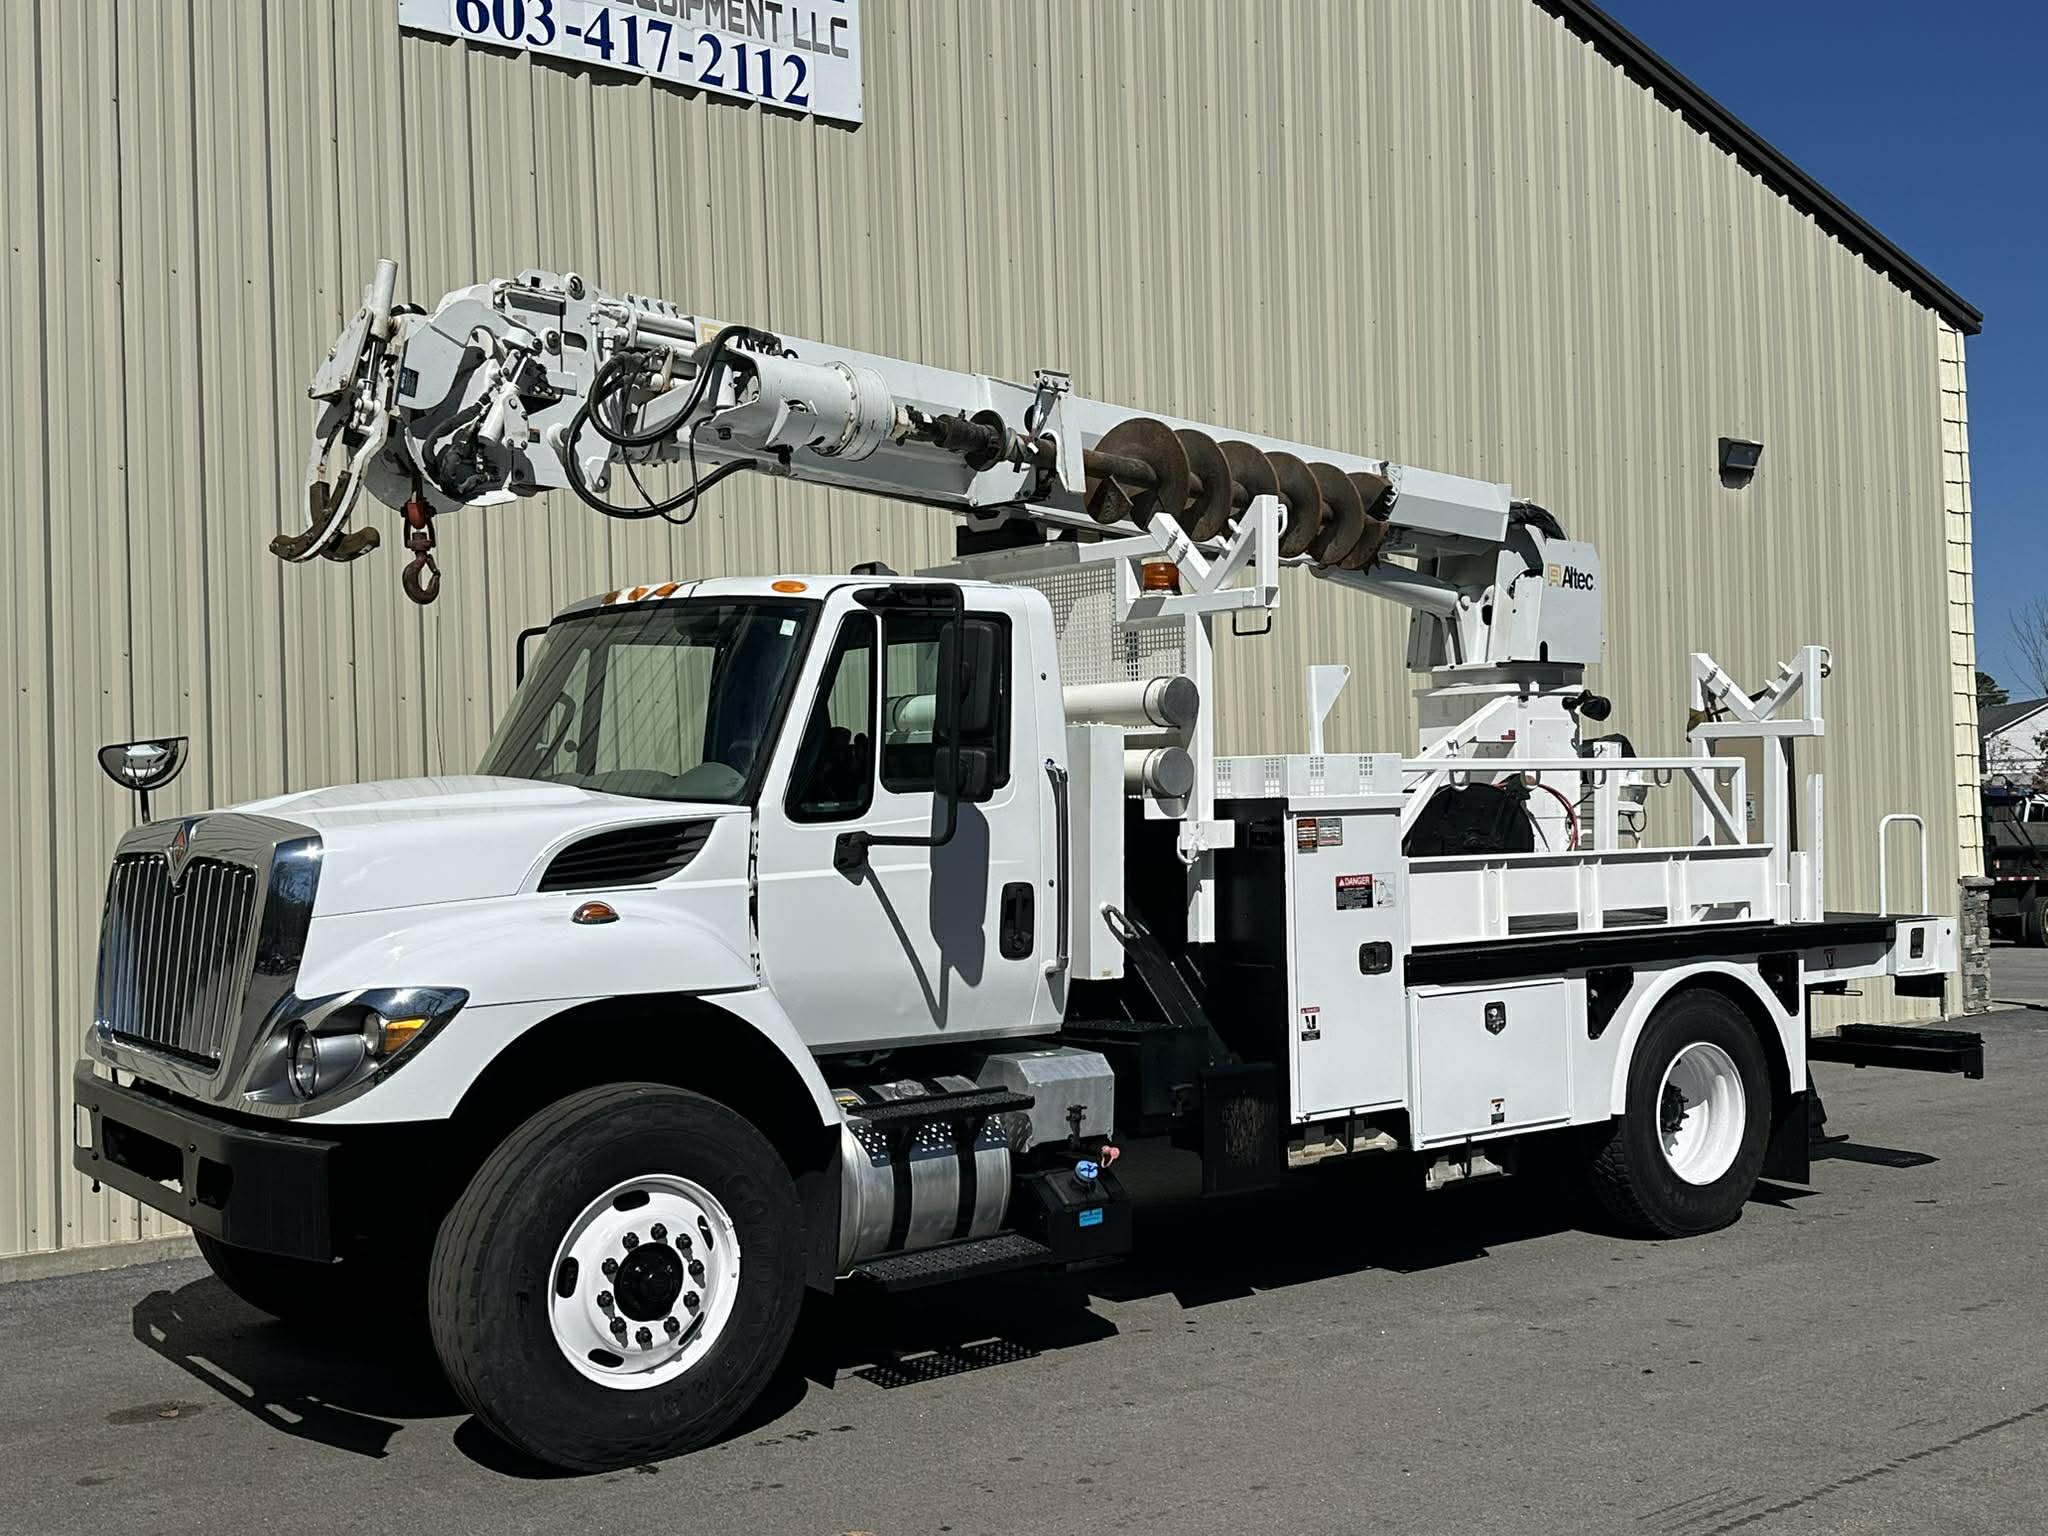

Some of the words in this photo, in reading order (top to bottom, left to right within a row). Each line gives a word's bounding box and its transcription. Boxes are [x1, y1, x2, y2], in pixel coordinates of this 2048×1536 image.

[616, 0, 783, 44] PMENT
[792, 7, 848, 59] LLC
[456, 0, 809, 107] 603-417-2112
[1561, 565, 1594, 591] Altec
[1344, 876, 1371, 886] DANGER
